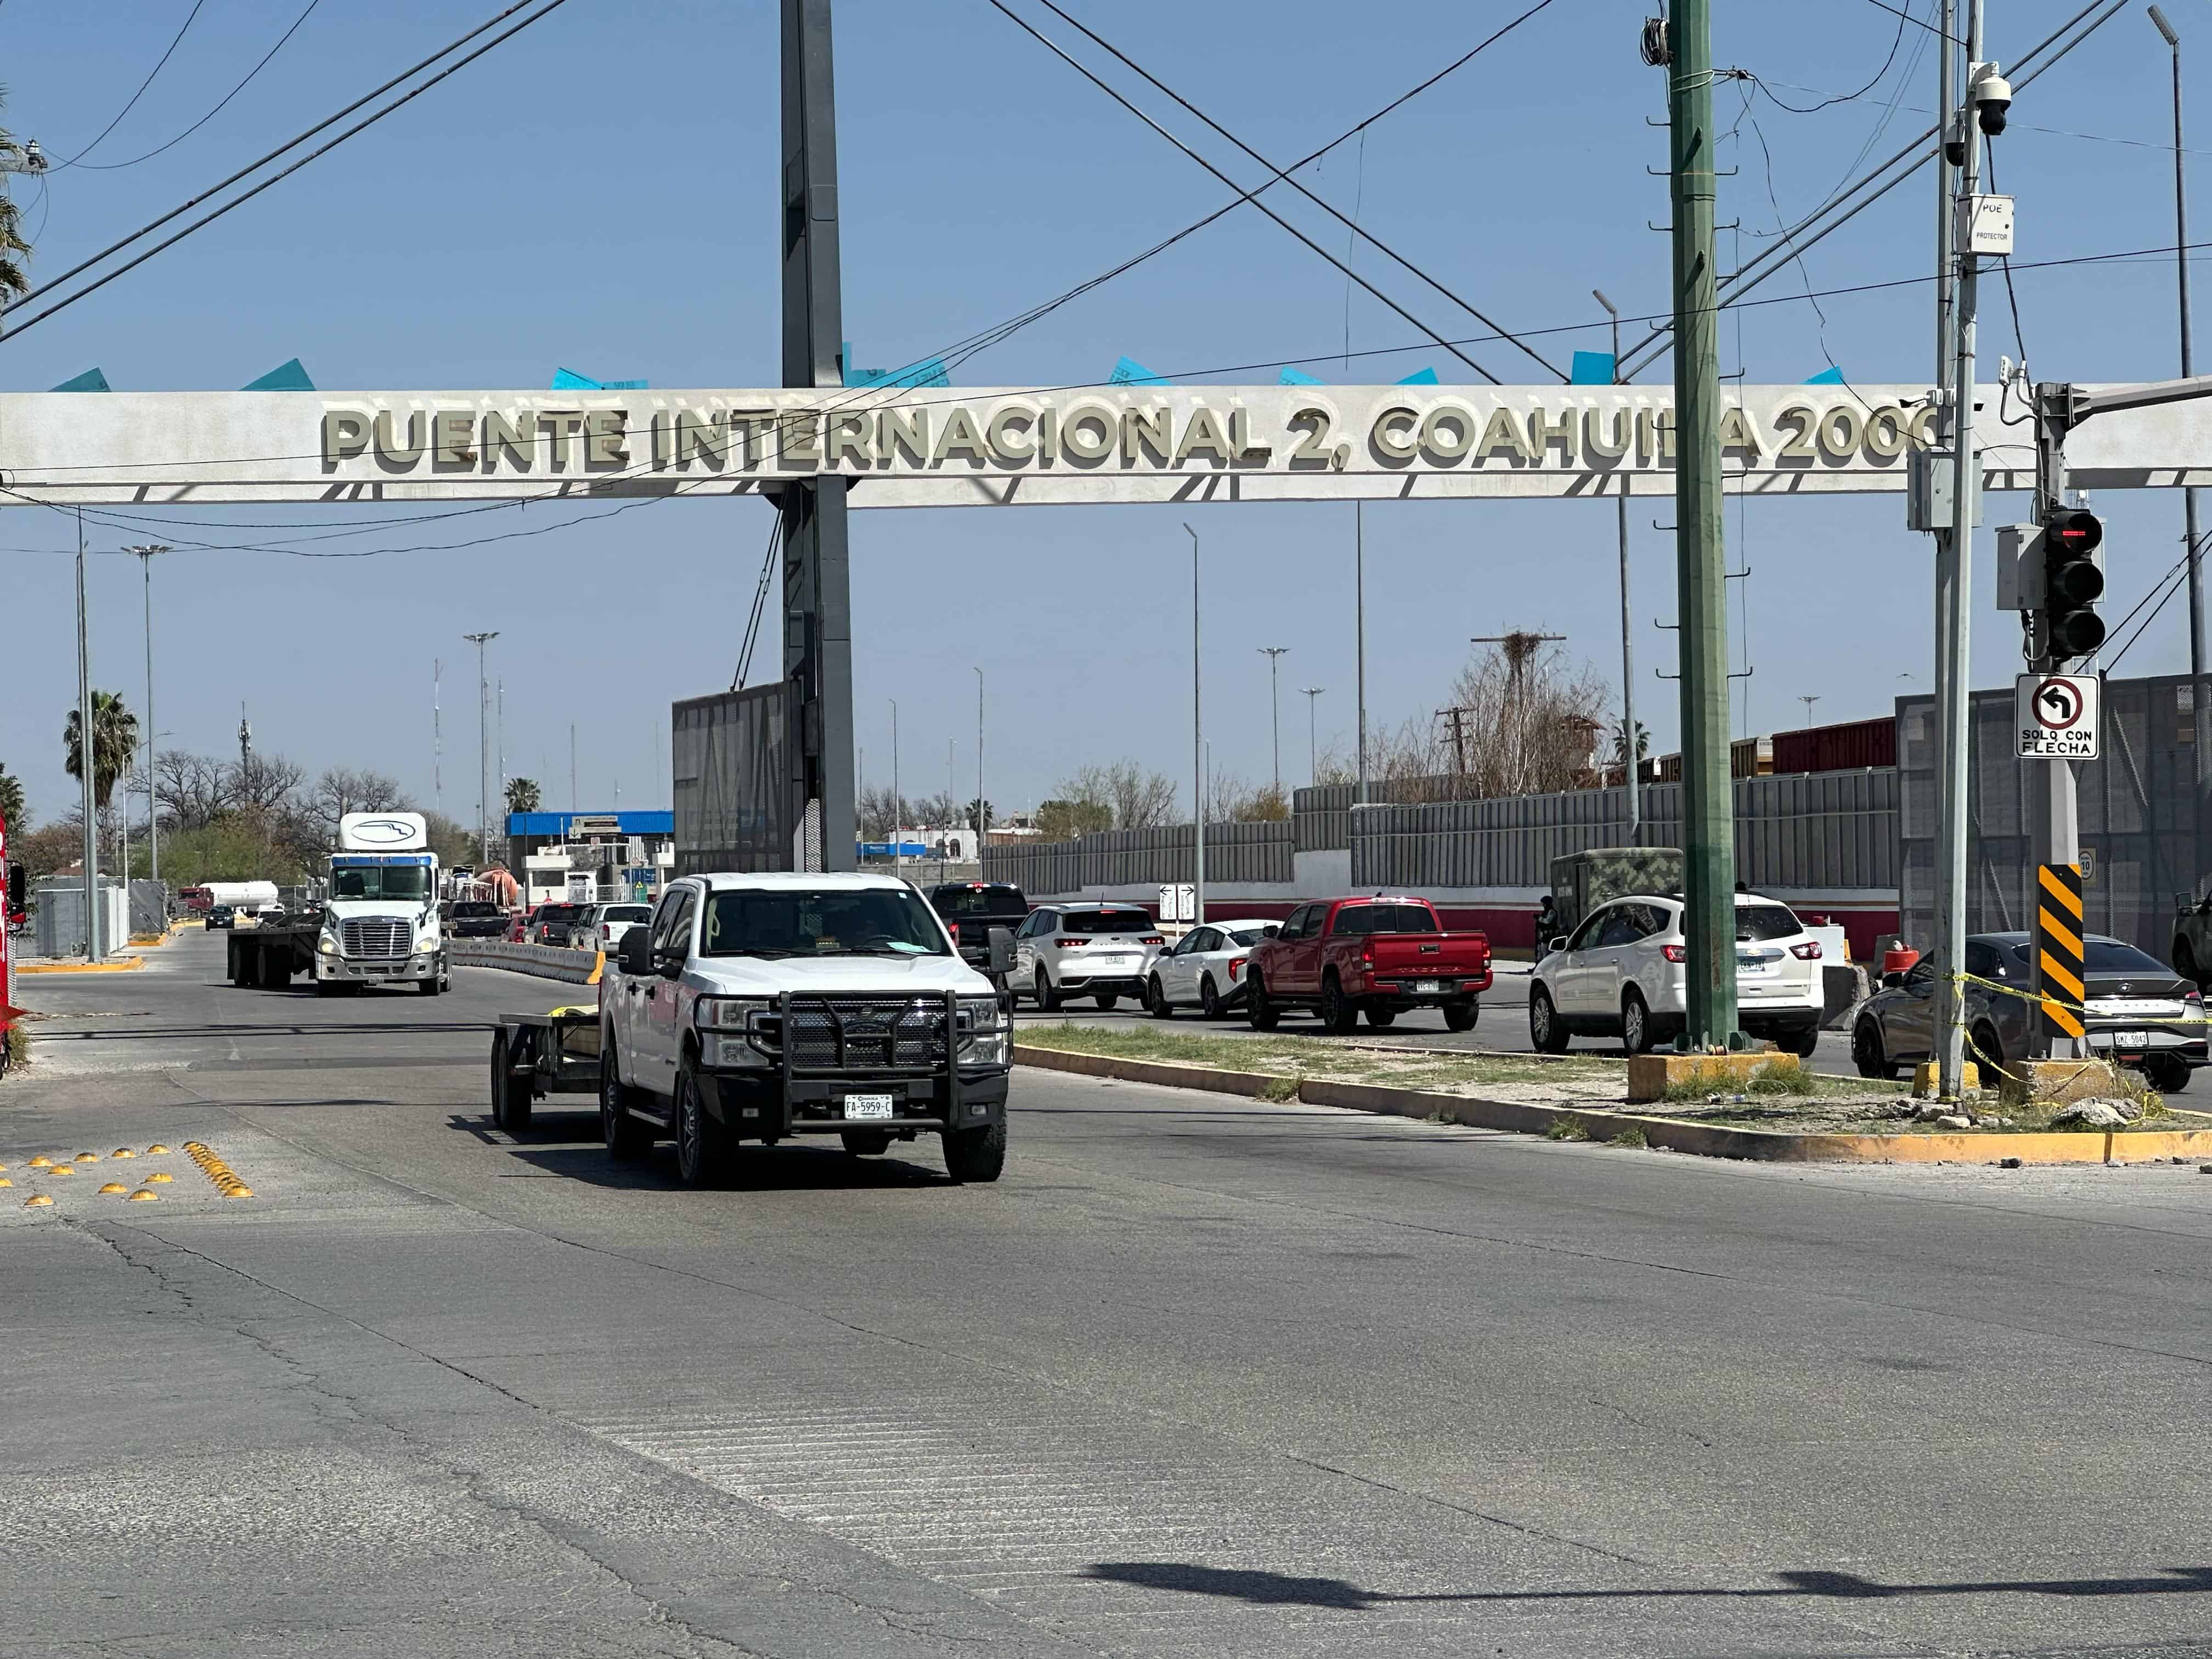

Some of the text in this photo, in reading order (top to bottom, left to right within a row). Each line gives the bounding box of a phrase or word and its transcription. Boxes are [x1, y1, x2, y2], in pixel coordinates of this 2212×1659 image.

[1983, 204, 2002, 213] POE
[1976, 232, 2008, 240] PROTECTOR
[324, 410, 629, 462] PUENTE
[656, 407, 1272, 461] INTERNACIONAL
[1291, 407, 1352, 471] 2,
[2022, 730, 2092, 741] SOLO CON
[2023, 742, 2091, 754] FLECHA
[2081, 861, 2090, 870] 10
[847, 1102, 890, 1112] FA-5959-C
